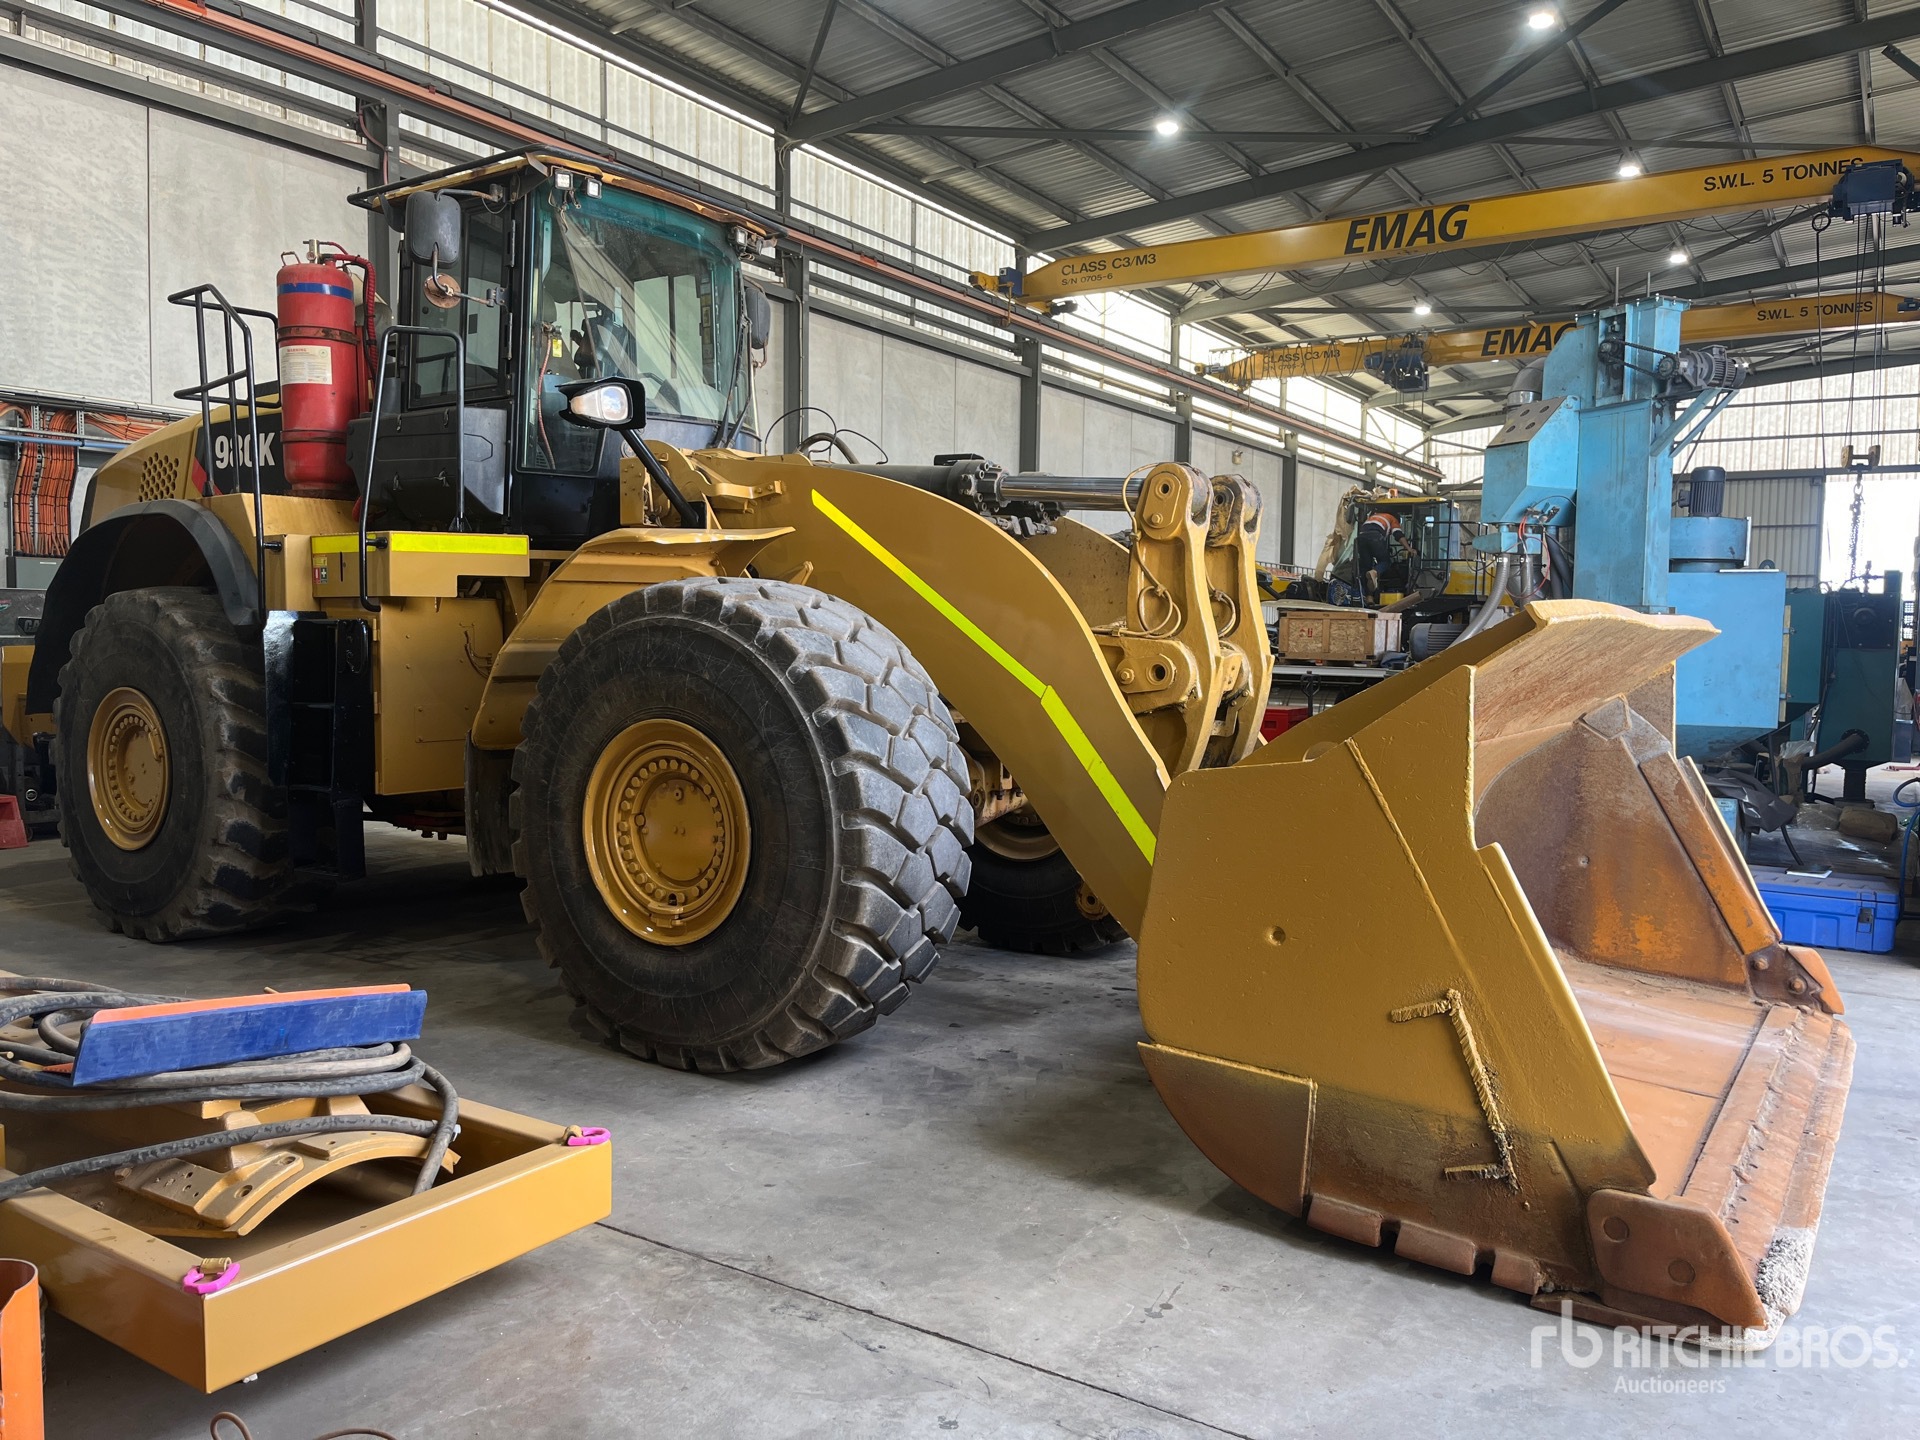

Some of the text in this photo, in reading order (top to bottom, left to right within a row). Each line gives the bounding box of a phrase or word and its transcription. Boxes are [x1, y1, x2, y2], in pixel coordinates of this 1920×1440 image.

[1703, 172, 1755, 192] S.W.L.
[1762, 169, 1774, 184] 5
[1344, 204, 1470, 255] EMAG
[1061, 253, 1156, 276] CLASS C3/M3
[1061, 272, 1113, 286] S/N 0705-6
[1757, 301, 1873, 321] S.W.L. 5 TONNES
[1263, 352, 1300, 364] CLASS
